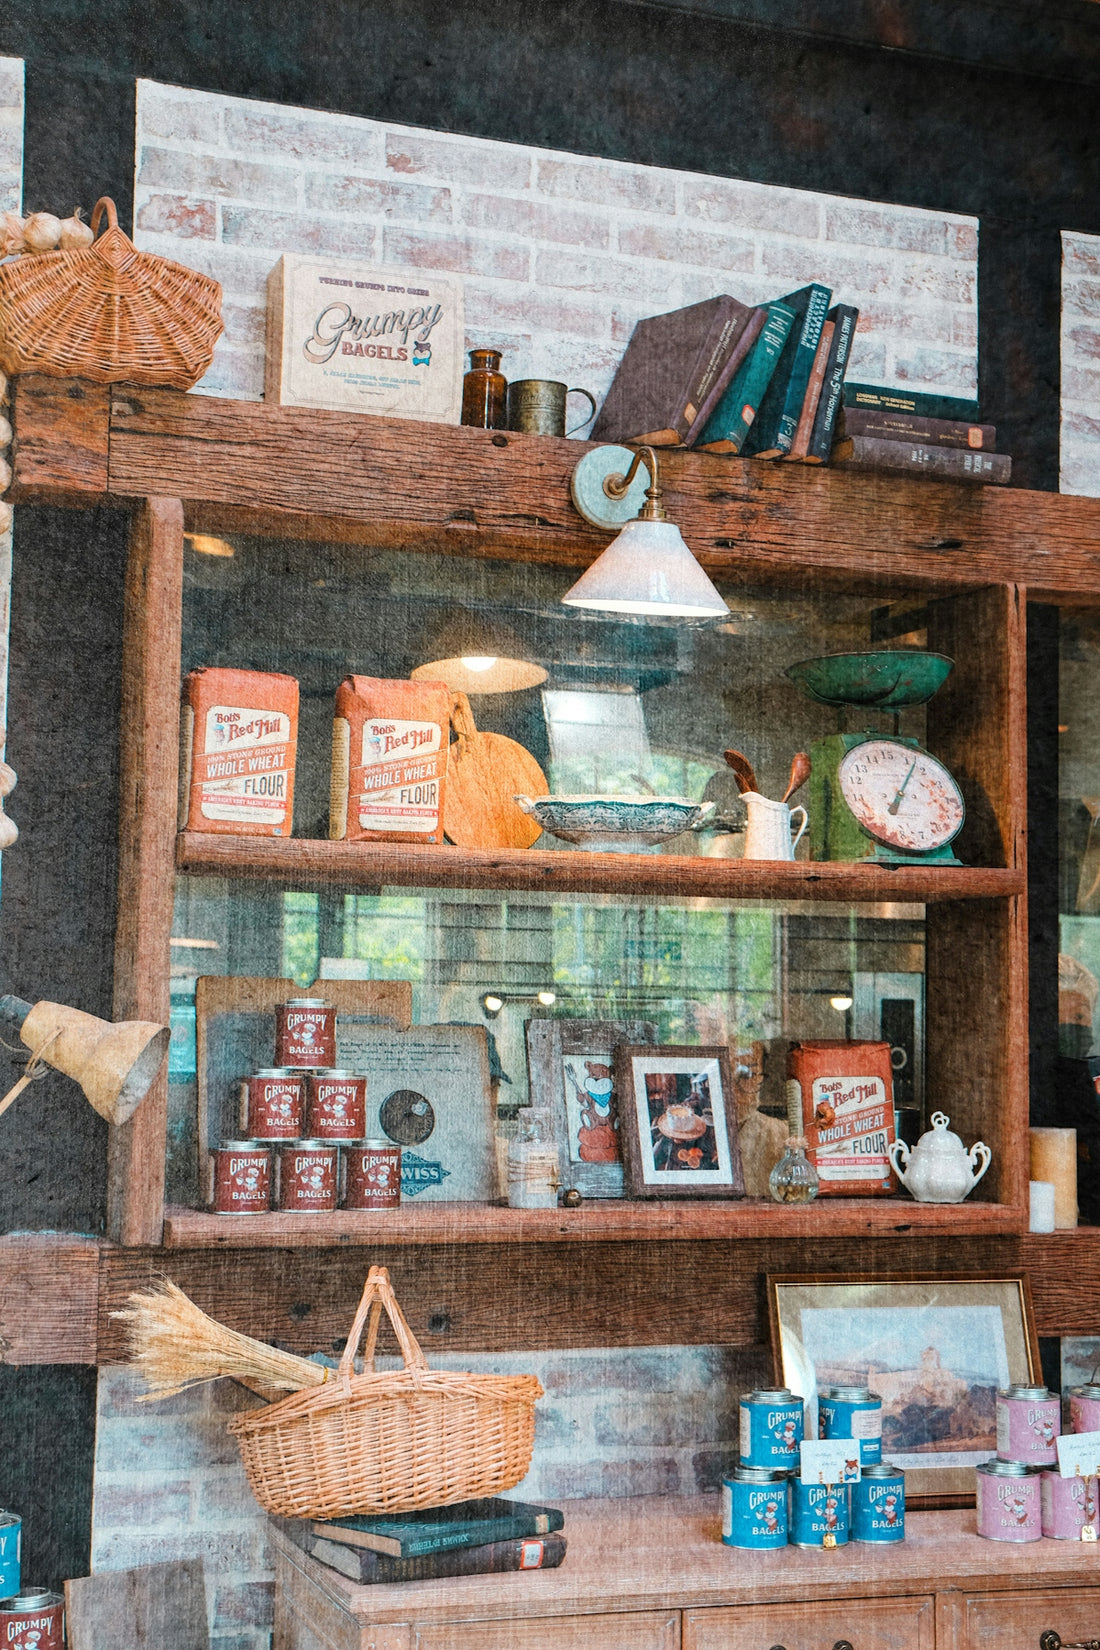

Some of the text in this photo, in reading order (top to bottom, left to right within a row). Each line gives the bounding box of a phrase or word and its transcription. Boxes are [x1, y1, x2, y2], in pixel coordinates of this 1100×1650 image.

[302, 301, 444, 364] Grumpy
[841, 315, 852, 334] JAMES
[341, 341, 408, 361] BAGELS
[836, 333, 849, 364] PATTERSON
[833, 367, 843, 381] The
[830, 380, 840, 395] 5th
[824, 394, 838, 431] Horseman
[215, 712, 241, 724] Bob's
[228, 717, 281, 743] Red Mill
[370, 724, 396, 736] Bob's
[384, 728, 433, 755] Red Mill
[866, 755, 879, 764] 14
[881, 751, 894, 760] 15
[207, 753, 286, 778] WHOLE WHEAT
[855, 764, 868, 773] 13
[364, 762, 437, 790] WHOLE WHEAT
[850, 776, 862, 785] 12
[244, 774, 284, 797] FLOUR
[400, 783, 437, 805] FLOUR
[287, 1013, 327, 1031] GRUMPY
[289, 1046, 325, 1055] BAGELS
[264, 1085, 300, 1103] GRUMPY
[318, 1086, 358, 1102] GRUMPY
[820, 1081, 843, 1094] Bob's
[833, 1083, 878, 1109] Red Mill
[266, 1117, 300, 1126] BAGELS
[320, 1118, 356, 1126] BAGELS
[818, 1113, 885, 1144] WHOLE WHEAT
[853, 1133, 886, 1154] FLOUR
[230, 1158, 268, 1176] GRUMPY
[295, 1157, 333, 1174] GRUMPY
[362, 1155, 399, 1173] GRUMPY
[232, 1191, 266, 1200] BAGELS
[297, 1189, 332, 1198] BAGELS
[364, 1188, 397, 1196] BAGELS
[771, 1446, 801, 1454] BAGEL
[749, 1490, 786, 1510] GRUMPY
[808, 1487, 846, 1506] GRUMPY
[868, 1484, 904, 1503] GRUMPY
[997, 1485, 1035, 1502] GRUMPY
[752, 1525, 785, 1535] BAGELS
[811, 1522, 845, 1532] BAGELS
[872, 1519, 903, 1528] BAGELS
[1000, 1519, 1036, 1527] BAGELS
[7, 1616, 54, 1642] GRUMPY
